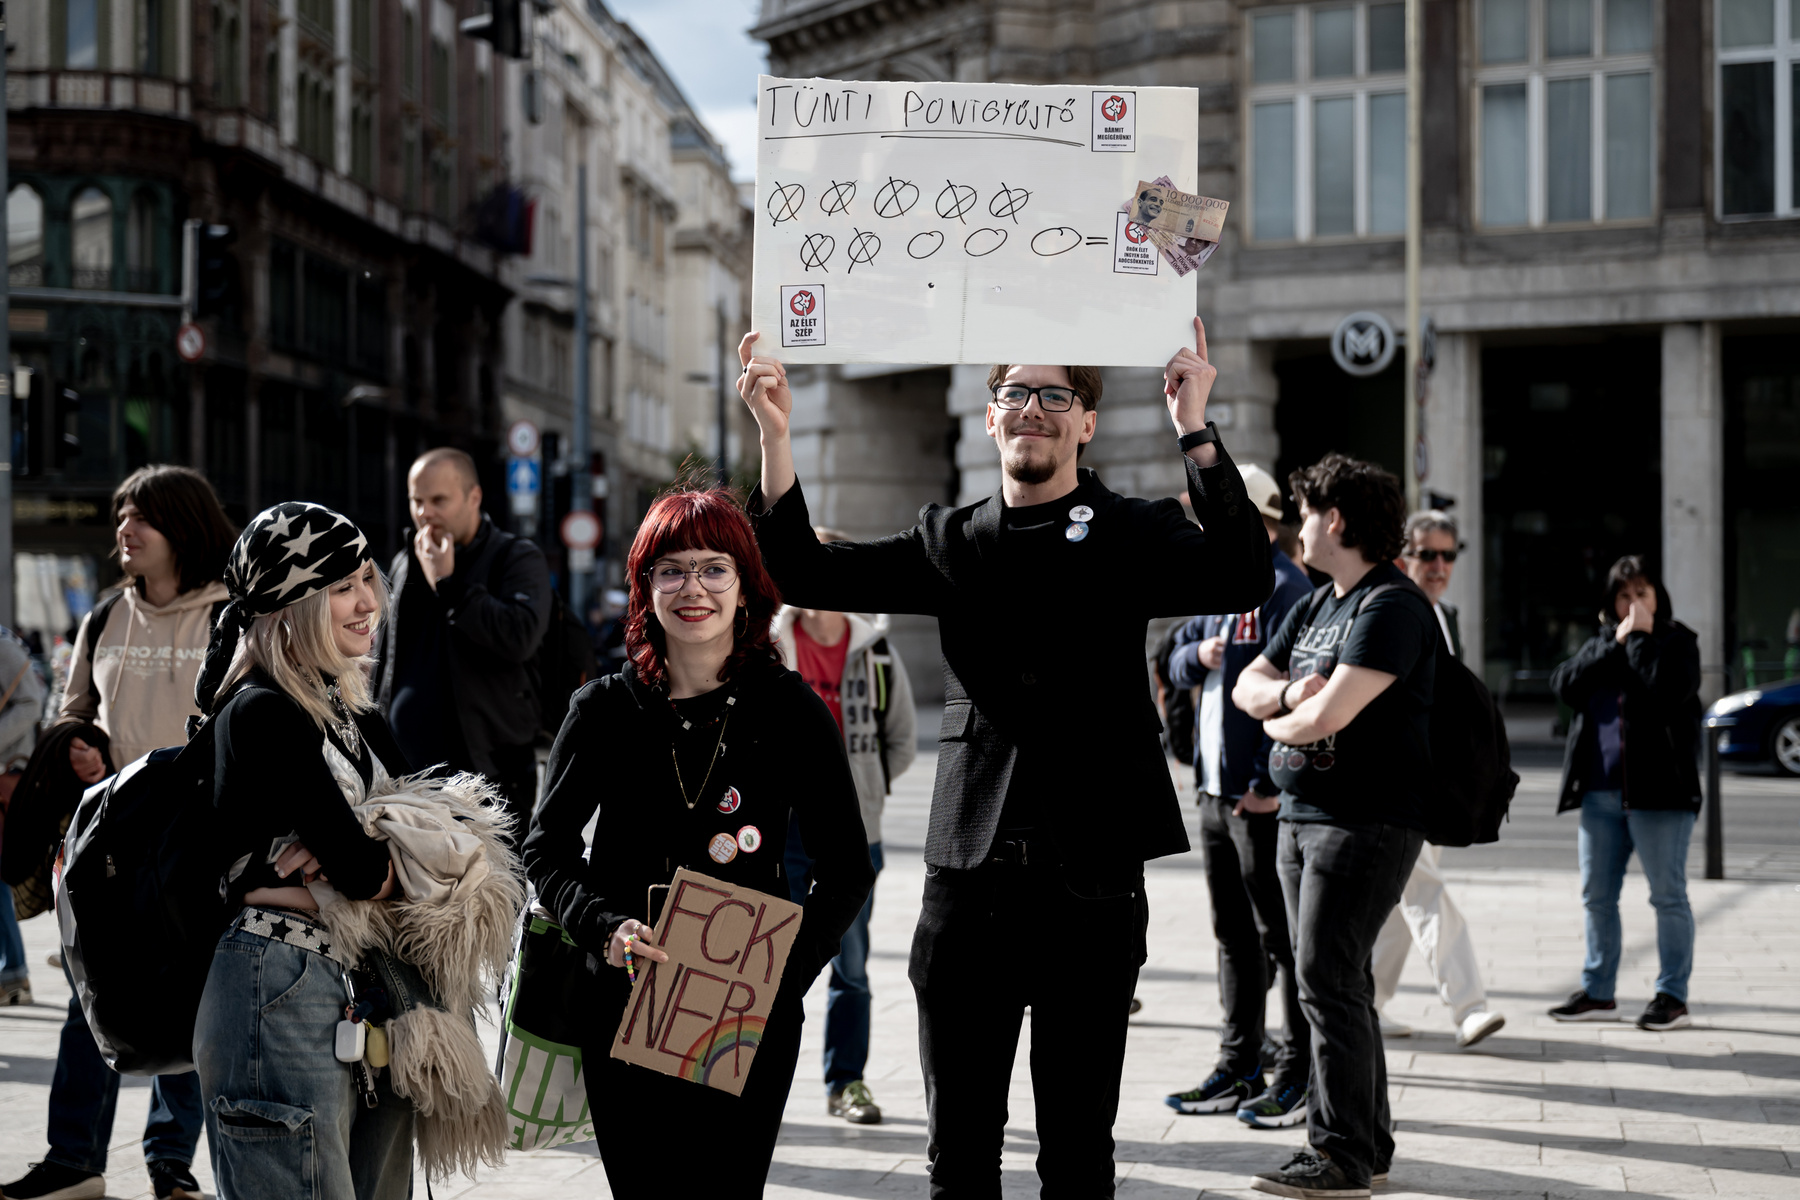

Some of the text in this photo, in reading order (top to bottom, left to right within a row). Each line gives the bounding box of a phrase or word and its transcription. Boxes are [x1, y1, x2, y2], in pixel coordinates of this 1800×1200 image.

[766, 85, 873, 128] TÜNTI
[790, 317, 817, 328] AZ ÉLET
[794, 327, 813, 337] SZÉP
[715, 839, 737, 864] NER
[658, 879, 798, 985] FCK
[622, 961, 756, 1079] NER
